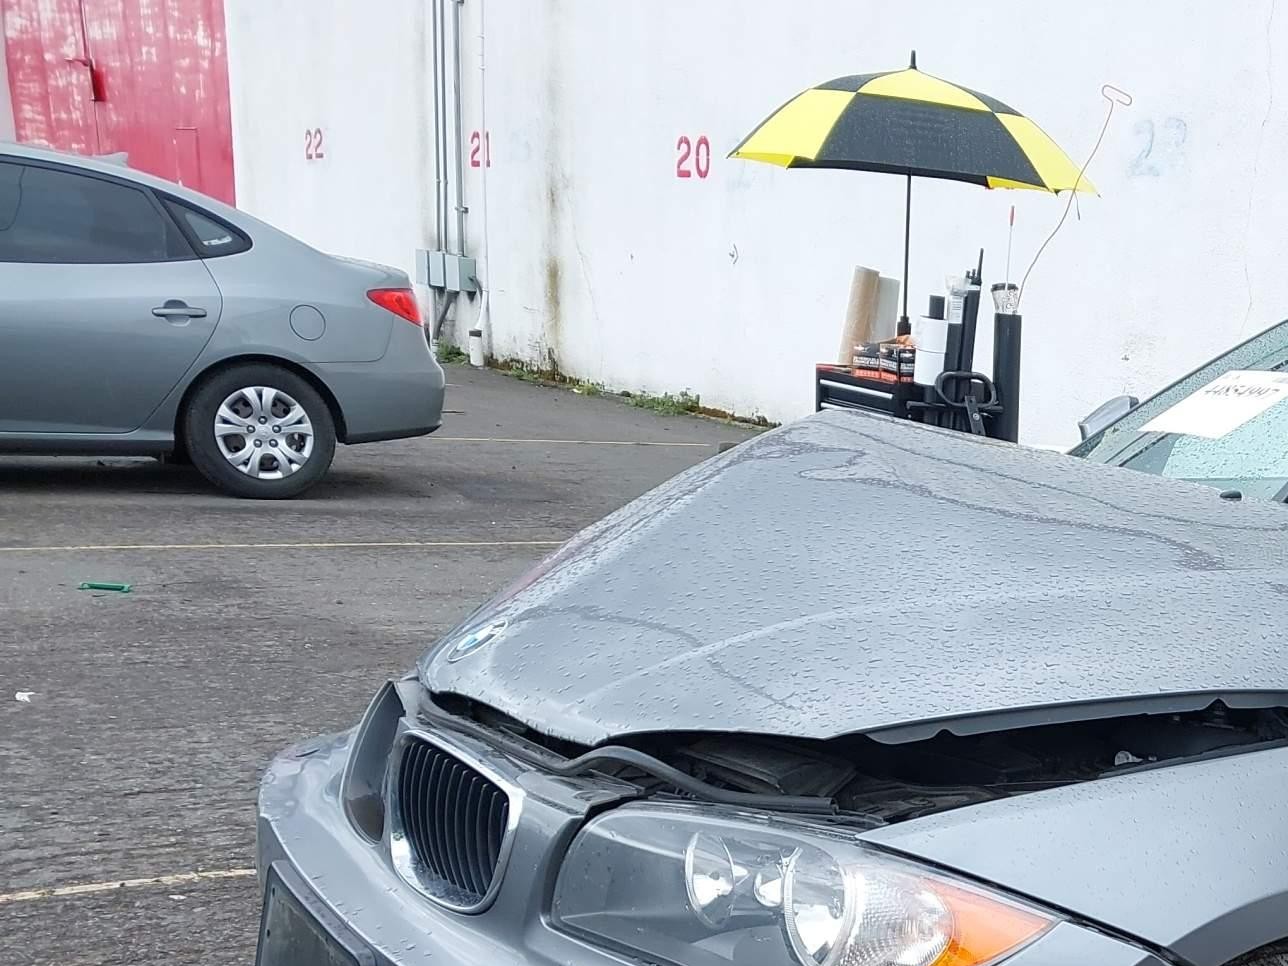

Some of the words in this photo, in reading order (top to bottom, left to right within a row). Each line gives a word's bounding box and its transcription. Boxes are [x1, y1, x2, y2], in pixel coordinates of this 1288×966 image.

[305, 128, 325, 160] 22
[470, 131, 491, 168] 21
[677, 136, 710, 179] 20
